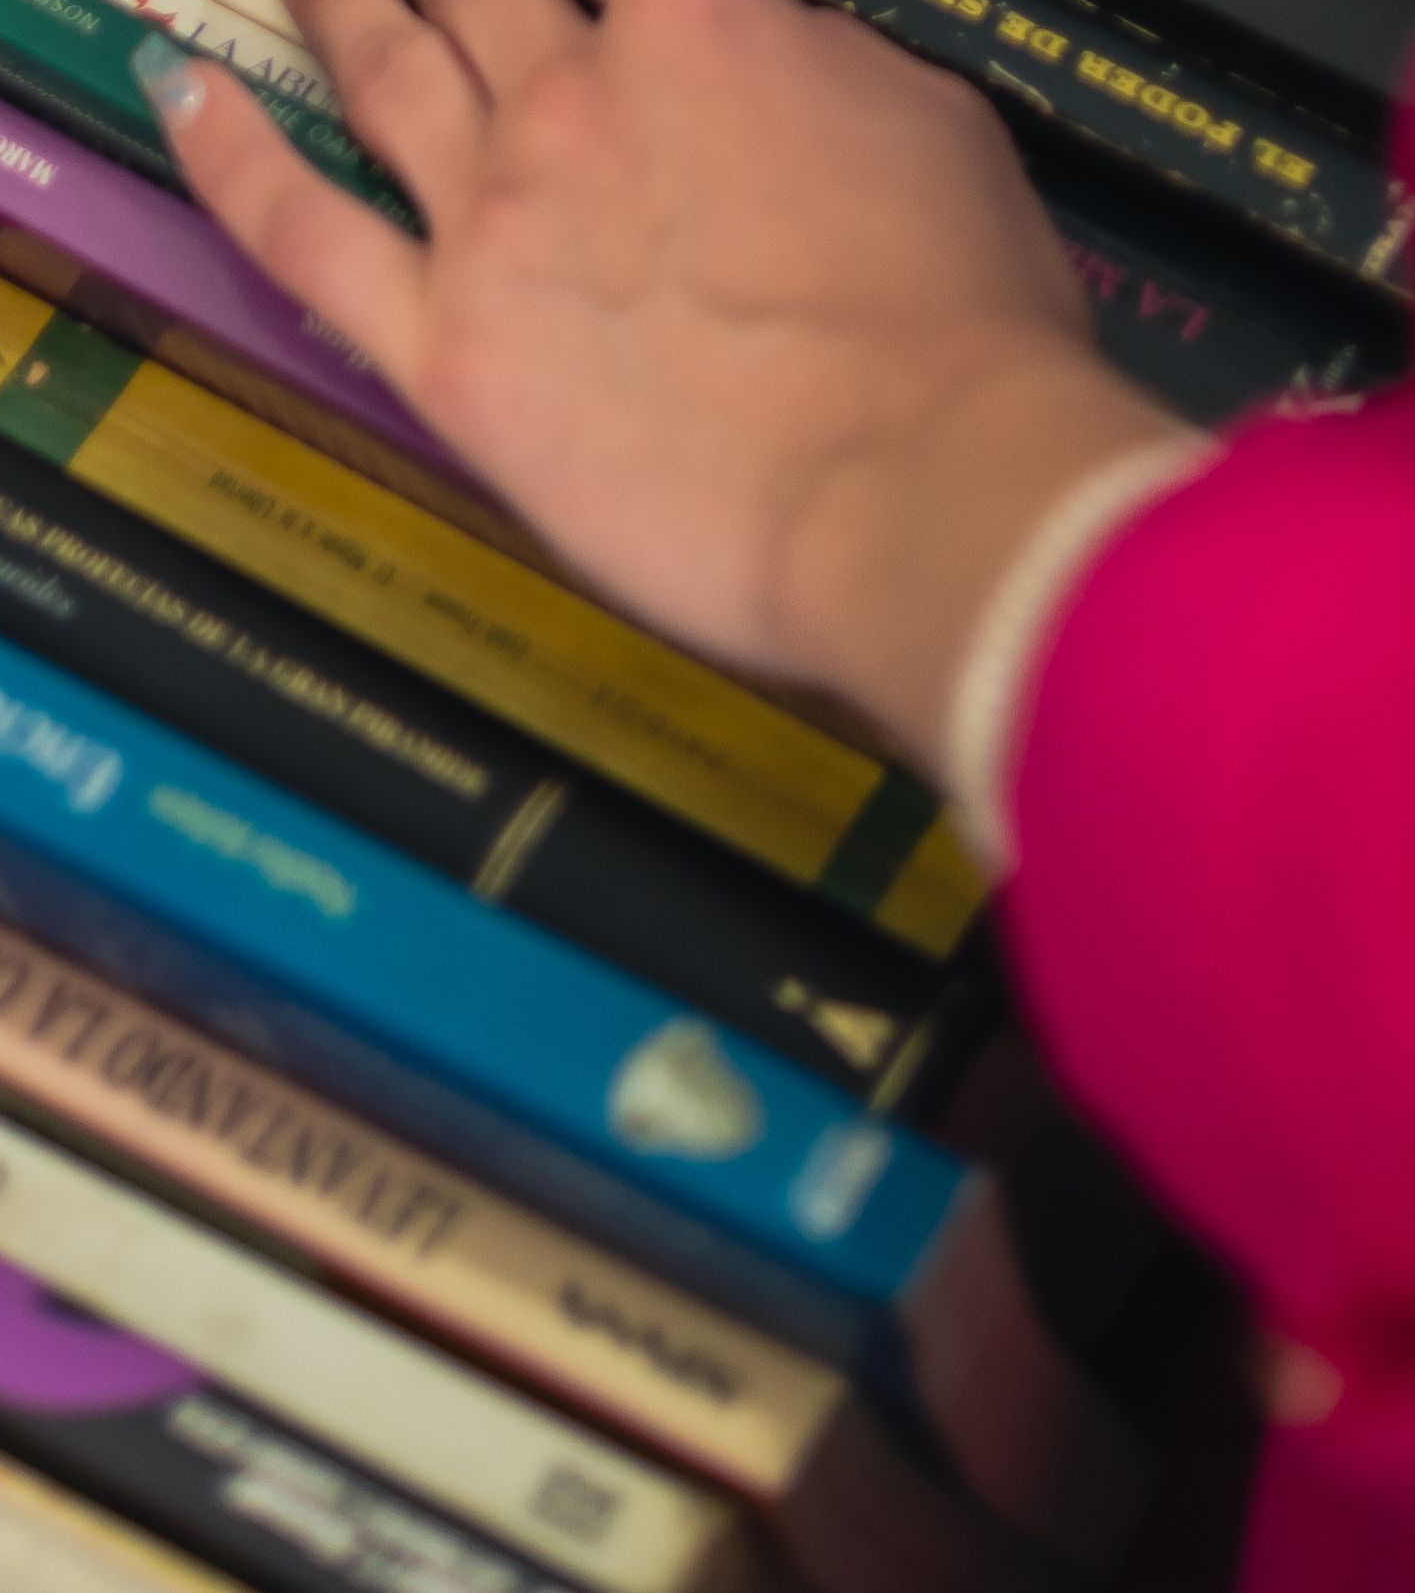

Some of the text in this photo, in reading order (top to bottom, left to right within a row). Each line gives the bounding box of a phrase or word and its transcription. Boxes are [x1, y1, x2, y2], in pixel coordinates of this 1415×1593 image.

[994, 6, 1068, 64] DE
[1071, 44, 1244, 152] PODER
[1247, 134, 1317, 189] EL
